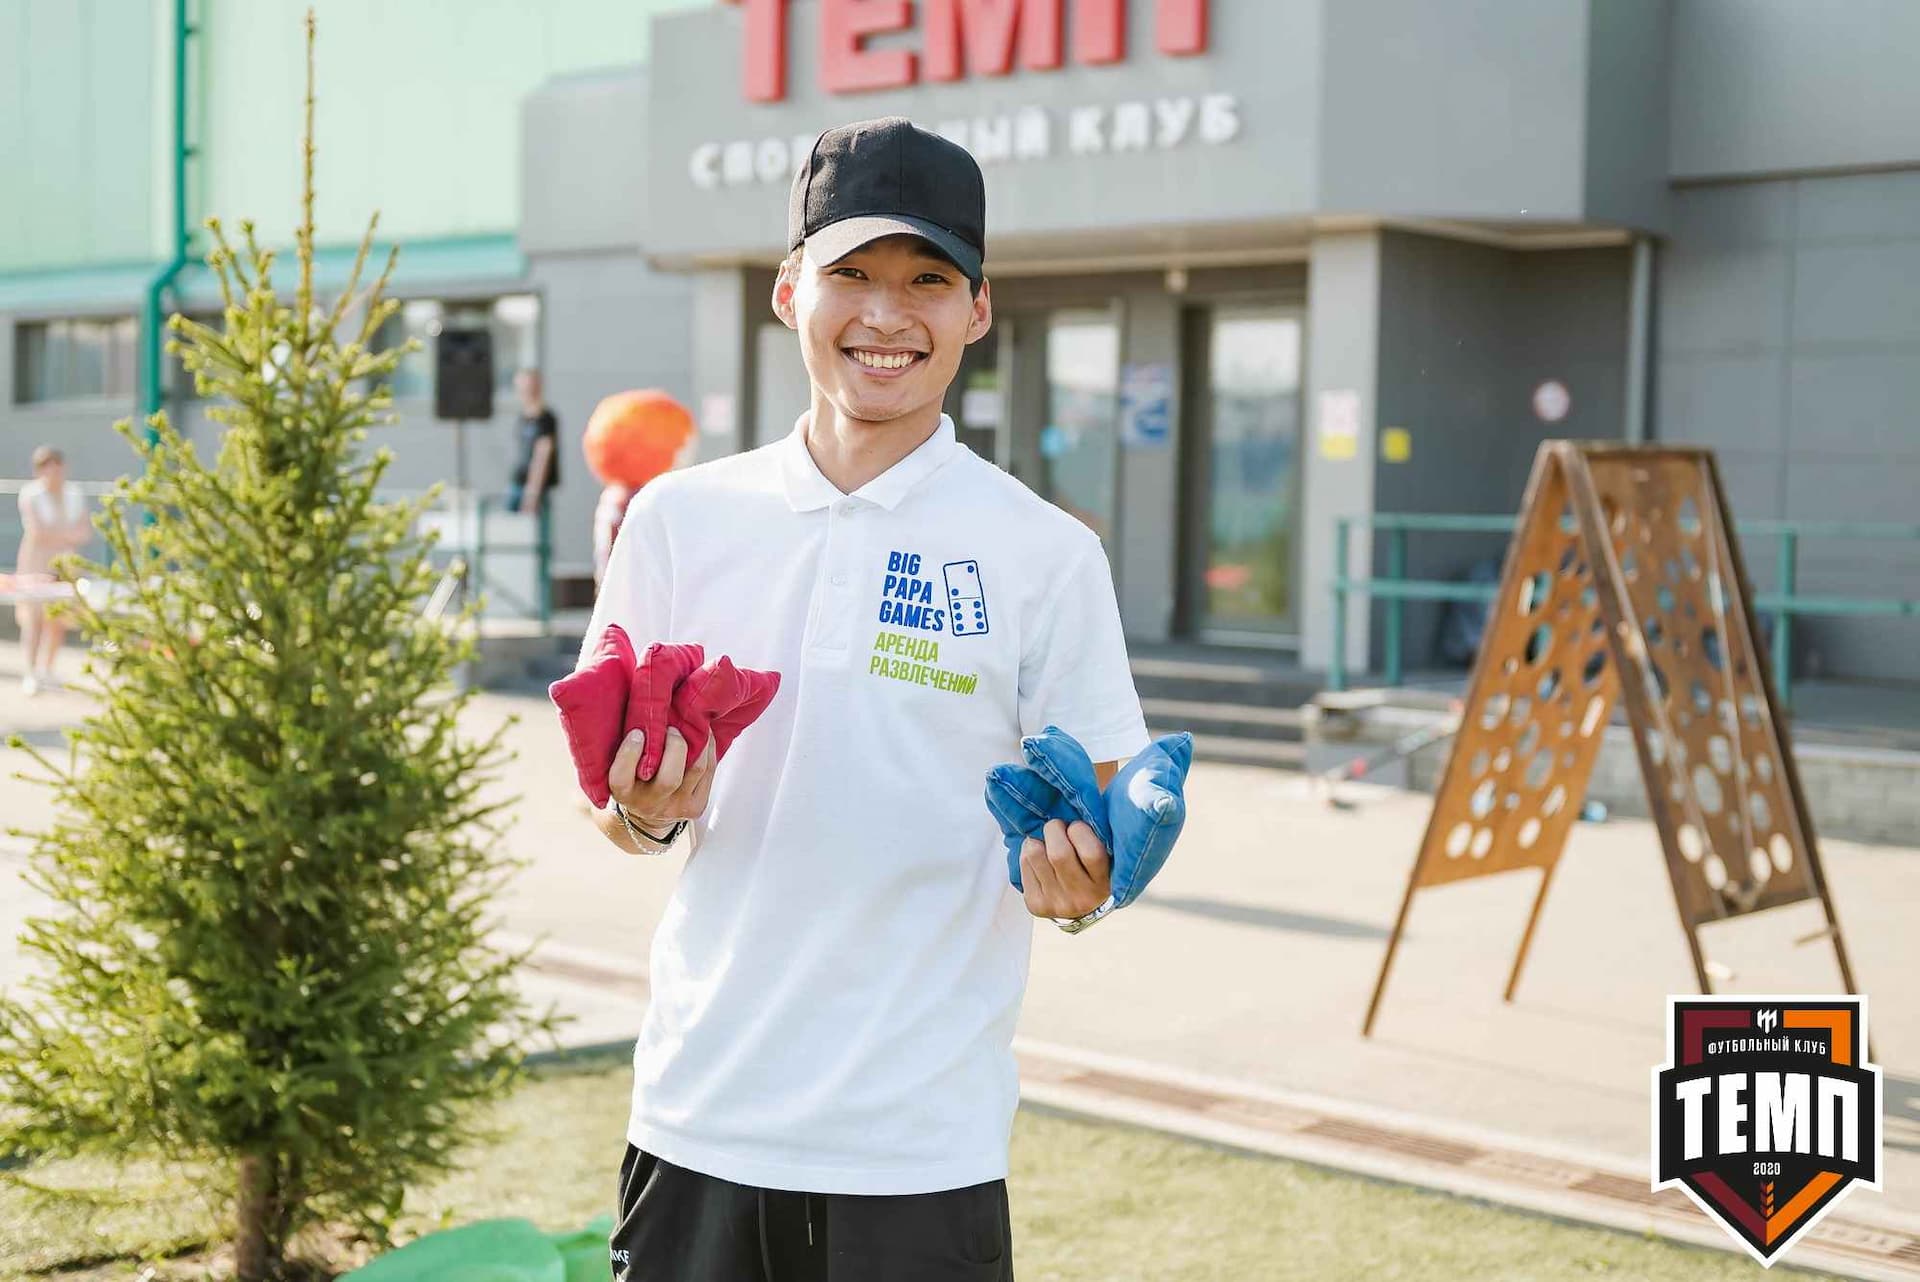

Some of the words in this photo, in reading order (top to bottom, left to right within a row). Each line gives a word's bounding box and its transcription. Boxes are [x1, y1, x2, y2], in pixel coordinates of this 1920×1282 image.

[1070, 93, 1239, 153] КЛУБ
[887, 551, 921, 575] BIG
[883, 574, 933, 604] PAPA
[879, 600, 945, 632] GAMES
[874, 632, 939, 663] АРЕНДА
[870, 655, 979, 695] РАЗВЛЕЧЕНИЙ
